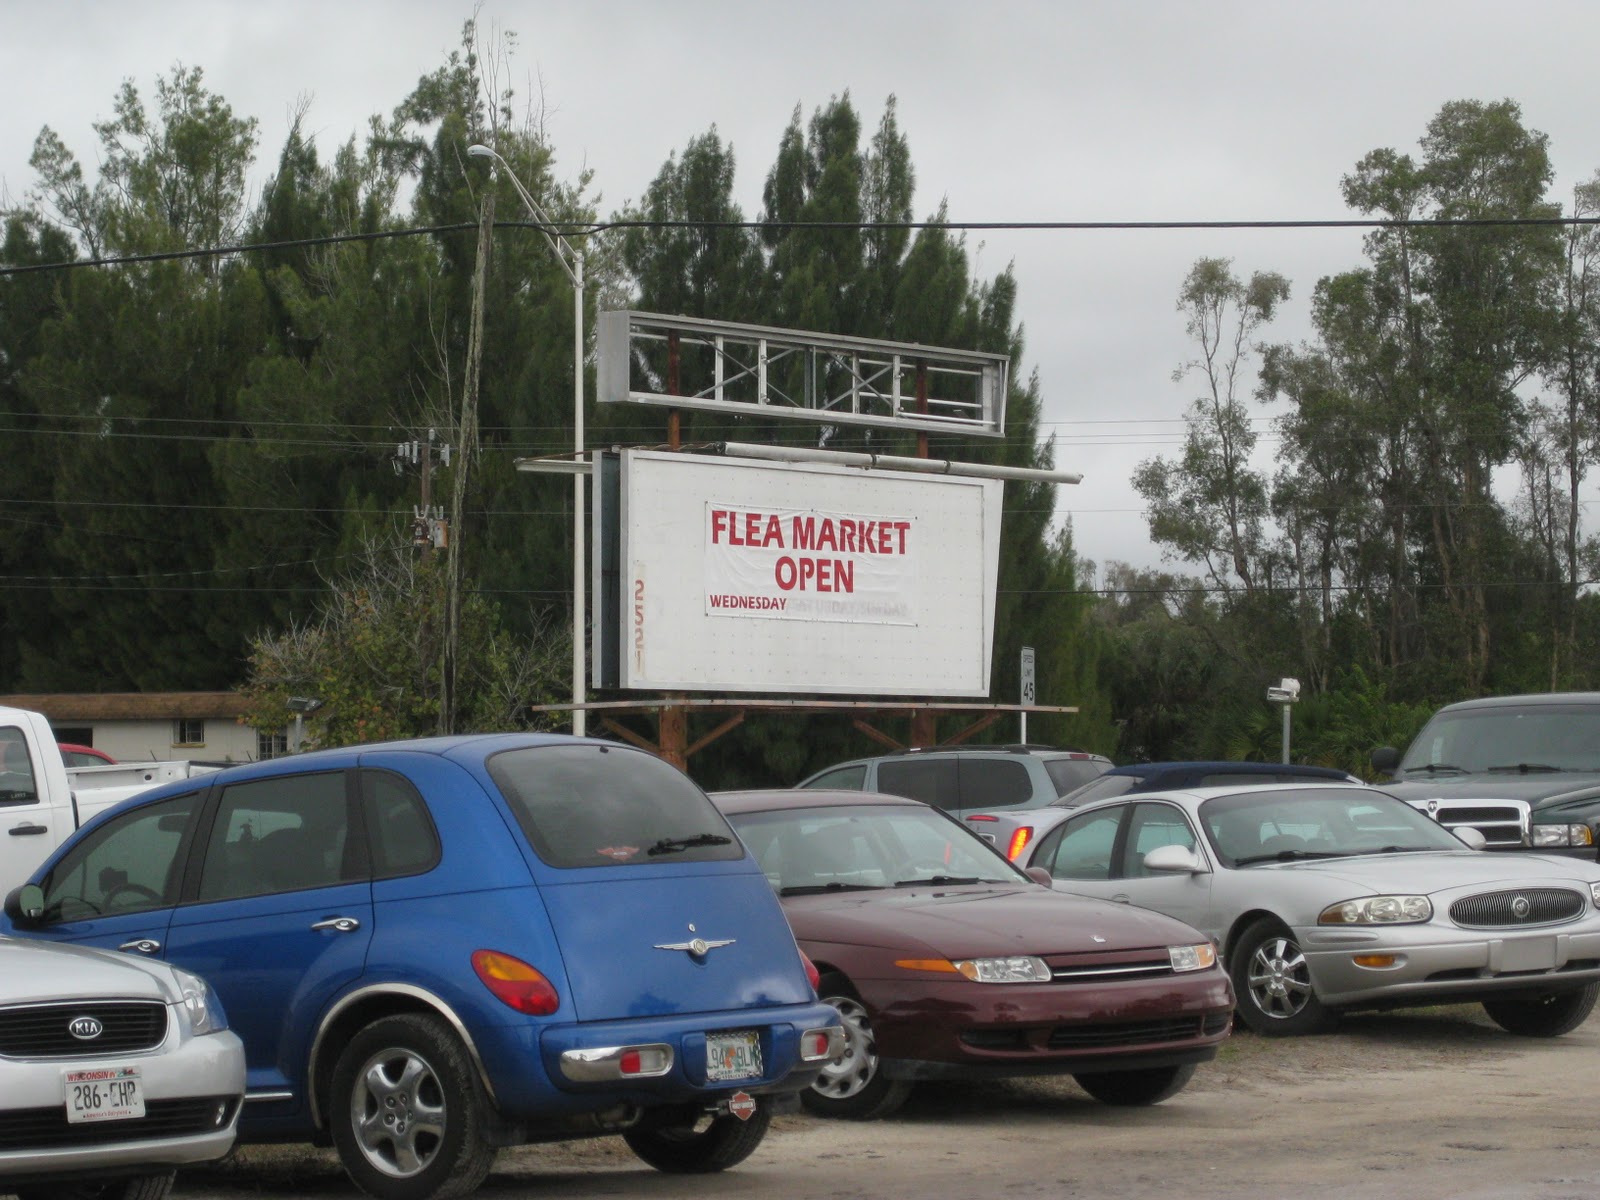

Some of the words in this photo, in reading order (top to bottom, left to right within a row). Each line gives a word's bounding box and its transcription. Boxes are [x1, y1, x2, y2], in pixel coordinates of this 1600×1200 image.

[711, 510, 785, 549] FLEA
[793, 515, 911, 554] MARKET
[775, 556, 854, 593] OPEN
[709, 595, 787, 610] WEDNESDAY
[1023, 682, 1034, 701] 45
[74, 1022, 99, 1034] KIA
[67, 1071, 109, 1082] WISCONSIN
